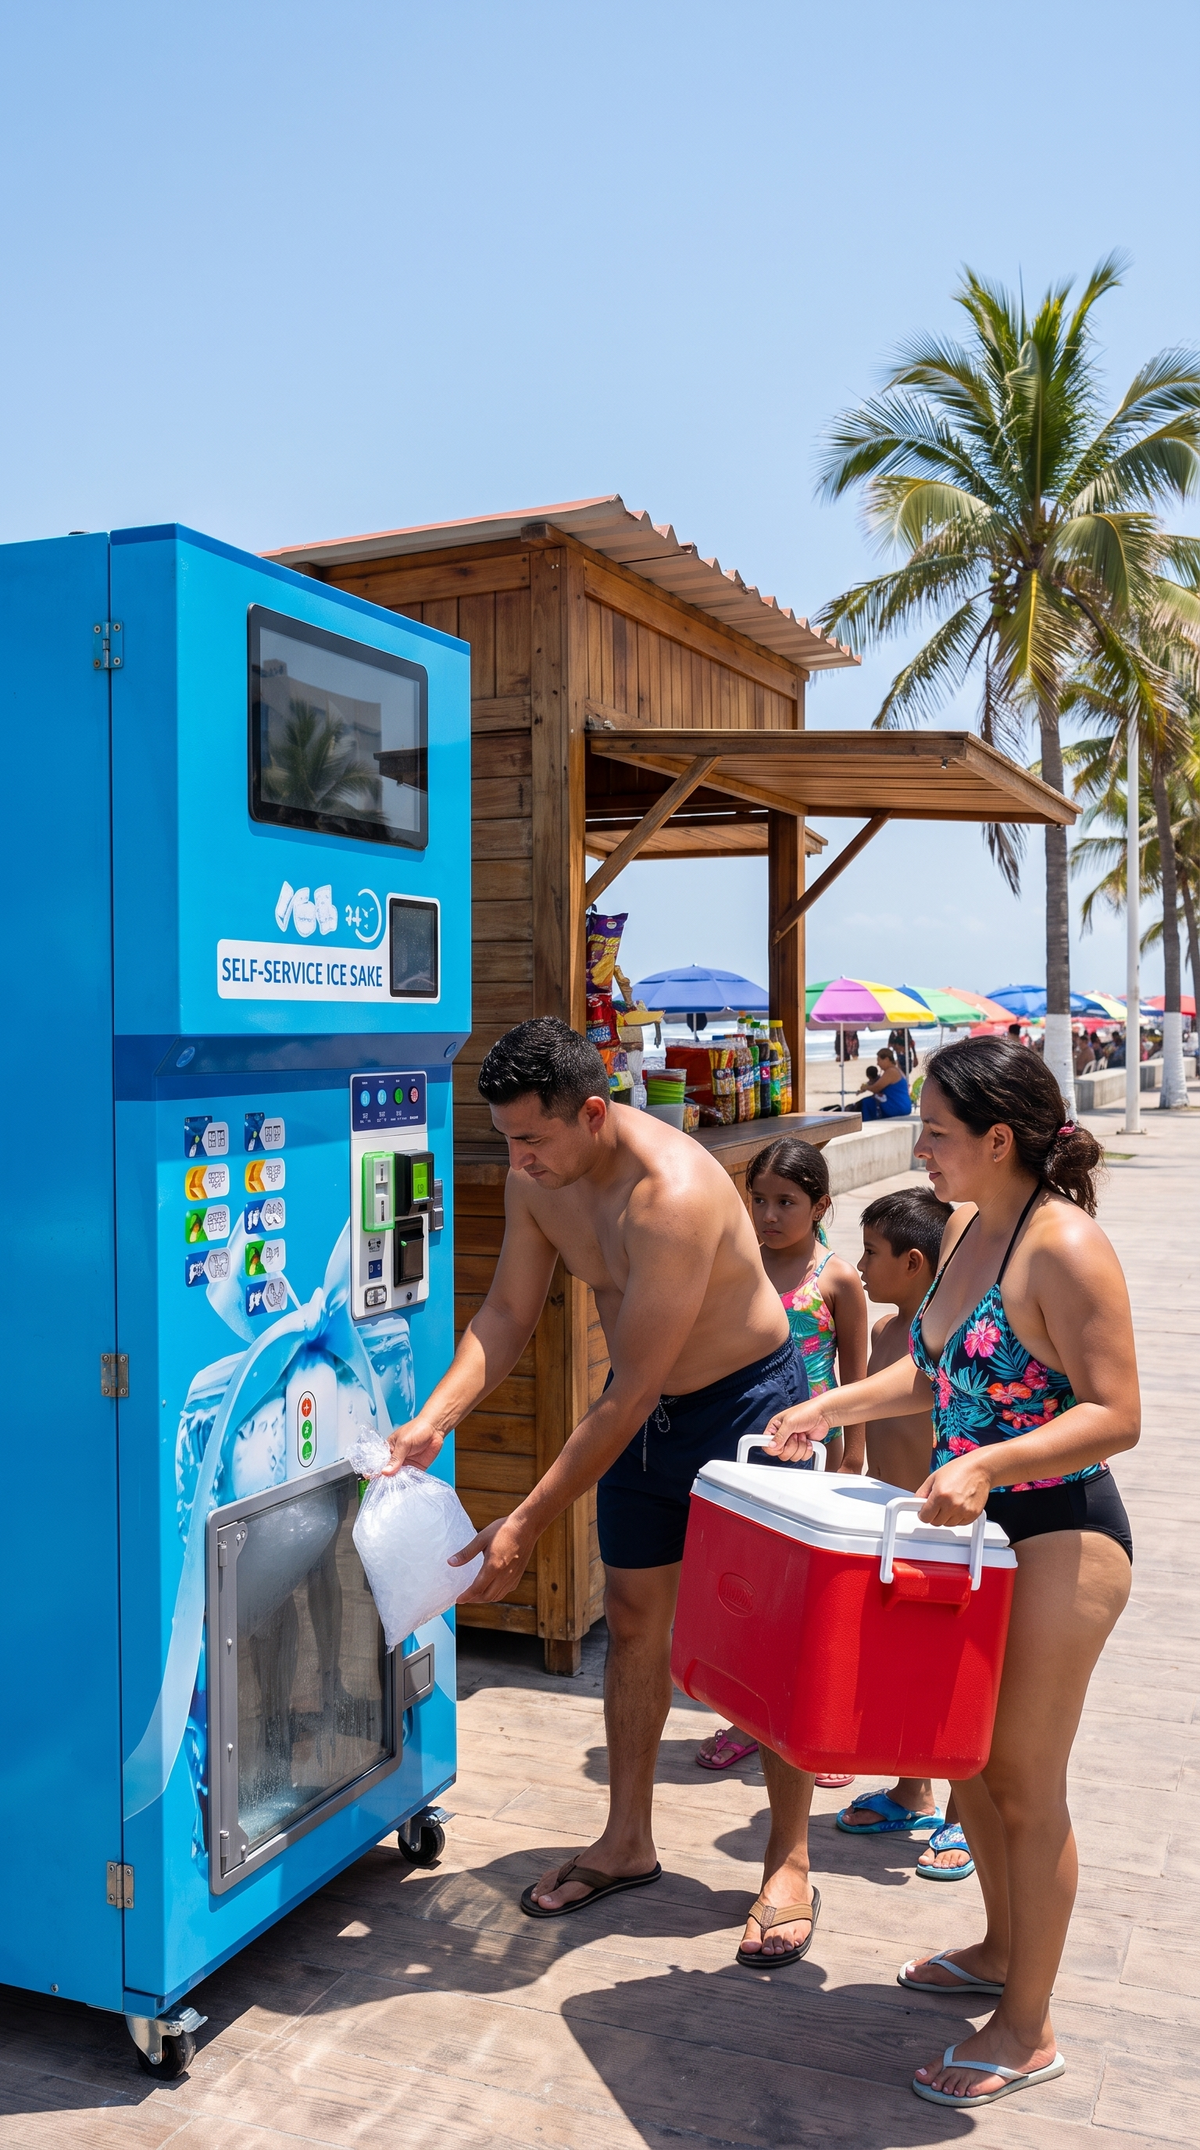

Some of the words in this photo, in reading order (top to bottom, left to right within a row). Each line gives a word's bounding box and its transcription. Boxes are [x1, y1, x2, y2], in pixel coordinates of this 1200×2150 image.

[222, 957, 323, 985] SELF-SERVICE
[326, 963, 347, 986] ICE
[350, 964, 383, 987] SAKE
